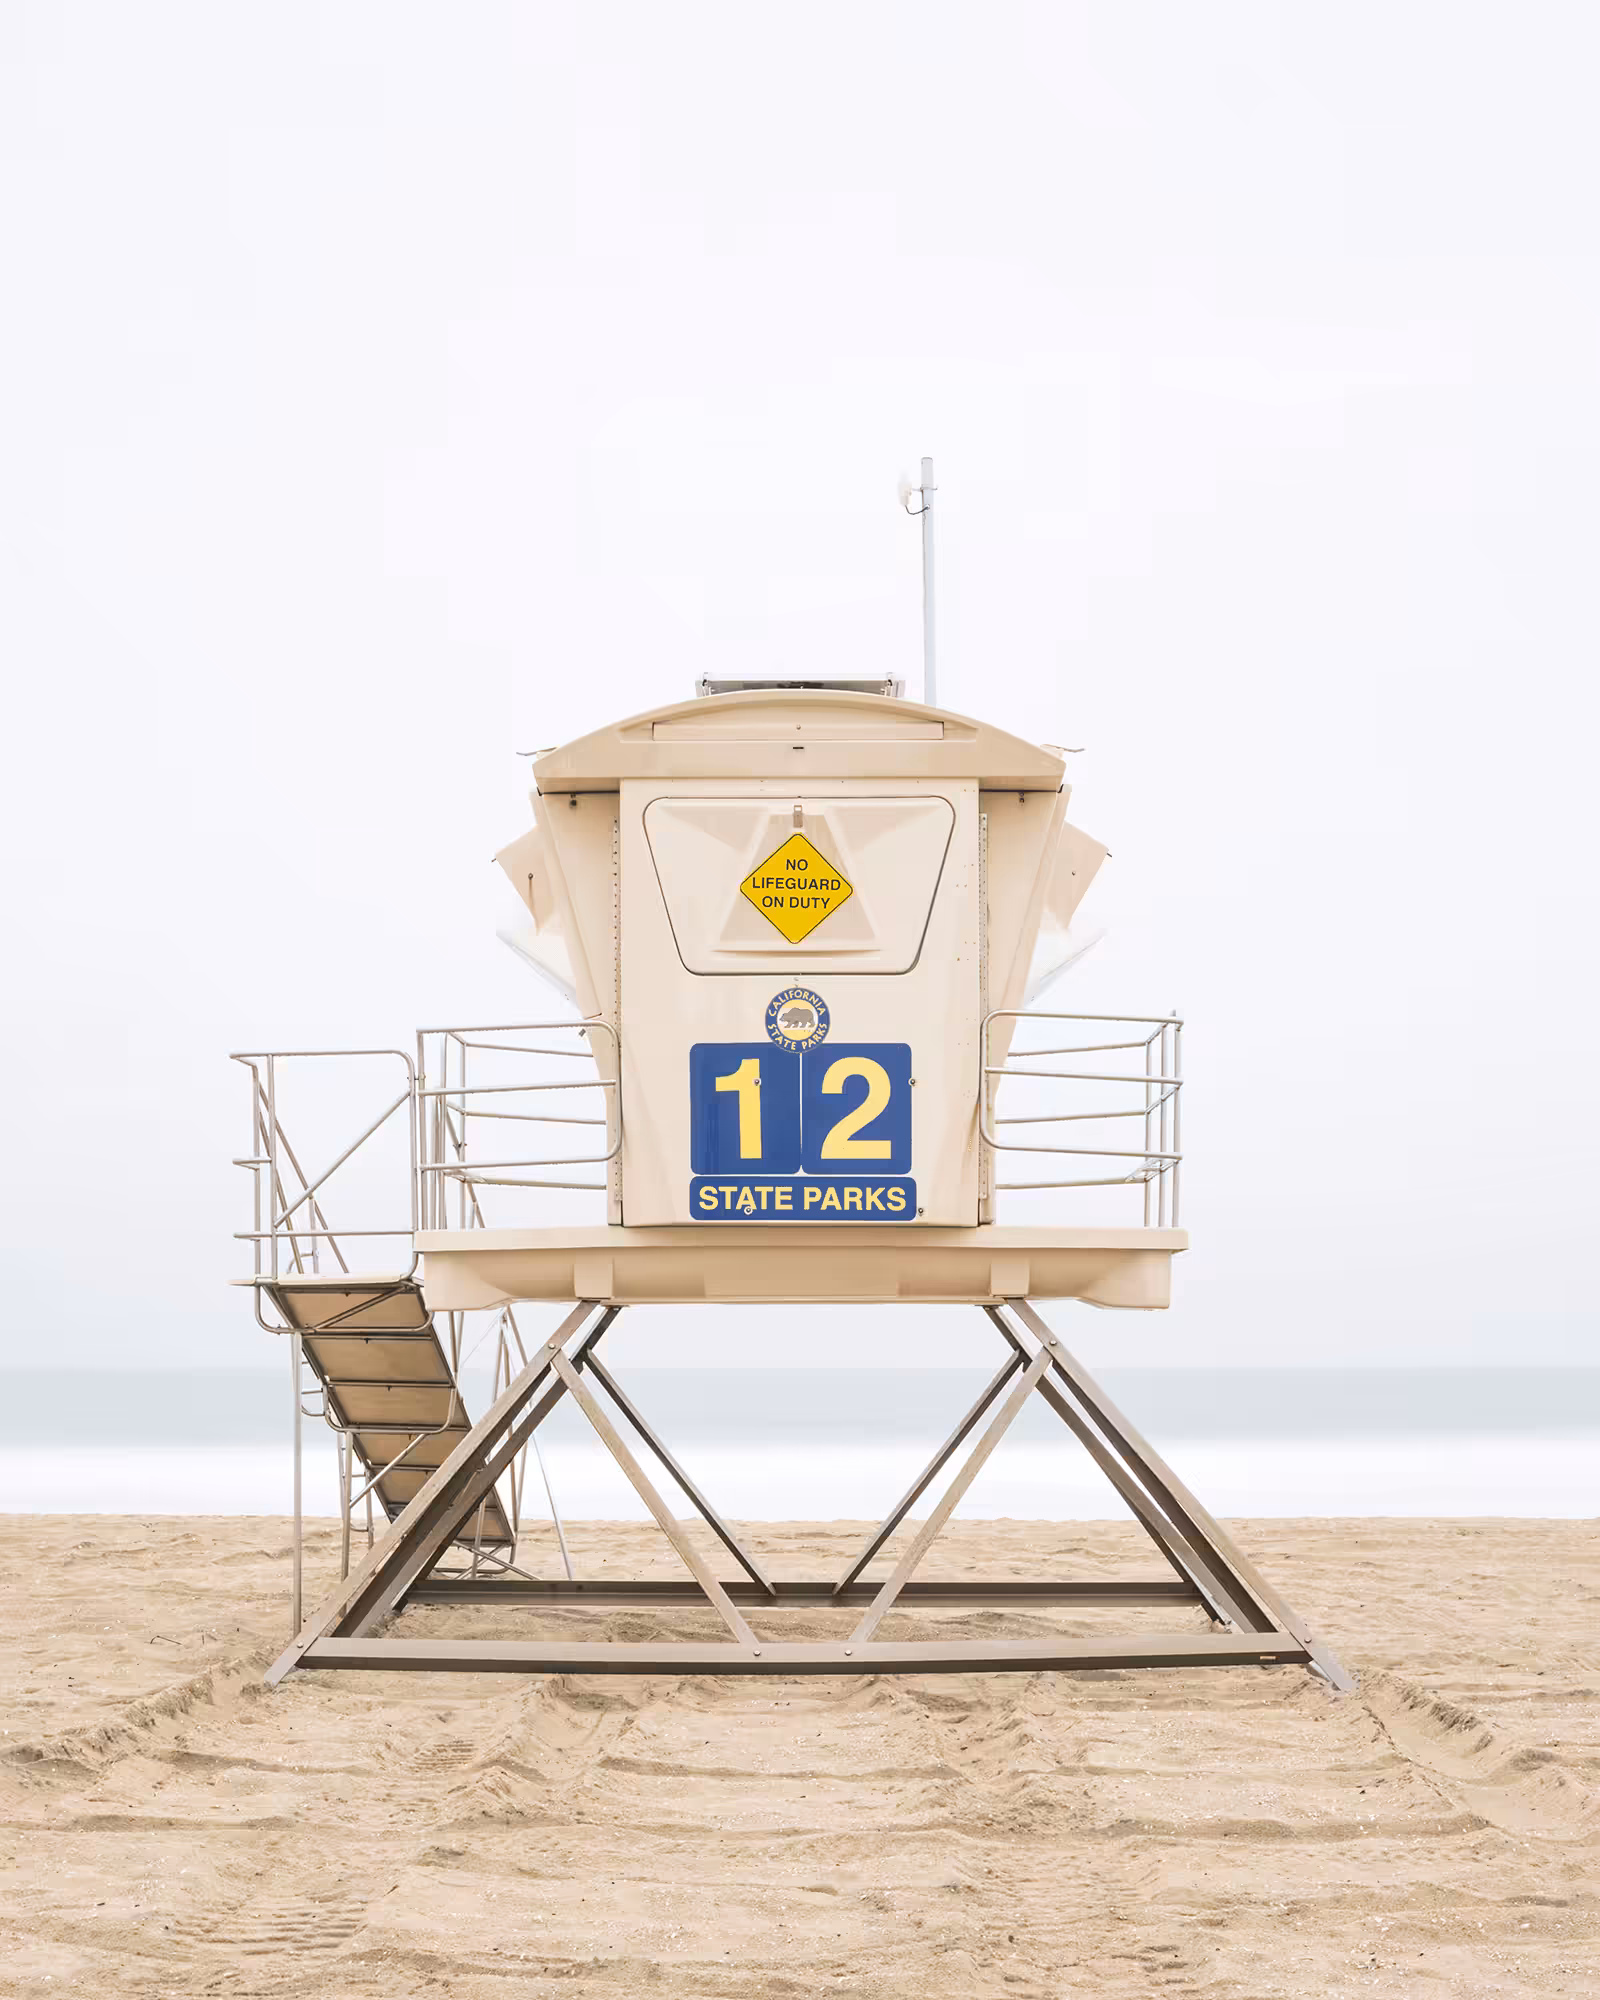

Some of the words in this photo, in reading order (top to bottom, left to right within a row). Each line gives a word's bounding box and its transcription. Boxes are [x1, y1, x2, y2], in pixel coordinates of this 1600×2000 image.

[786, 859, 809, 871] NO
[752, 877, 841, 891] LIFEGUARD
[762, 896, 784, 908] ON
[789, 896, 831, 909] DUTY
[768, 989, 826, 1017] CALIFORNIA
[767, 1023, 797, 1051] STATE
[801, 1023, 828, 1050] PARKS
[699, 1186, 794, 1211] STATE
[803, 1186, 907, 1212] PARKS
